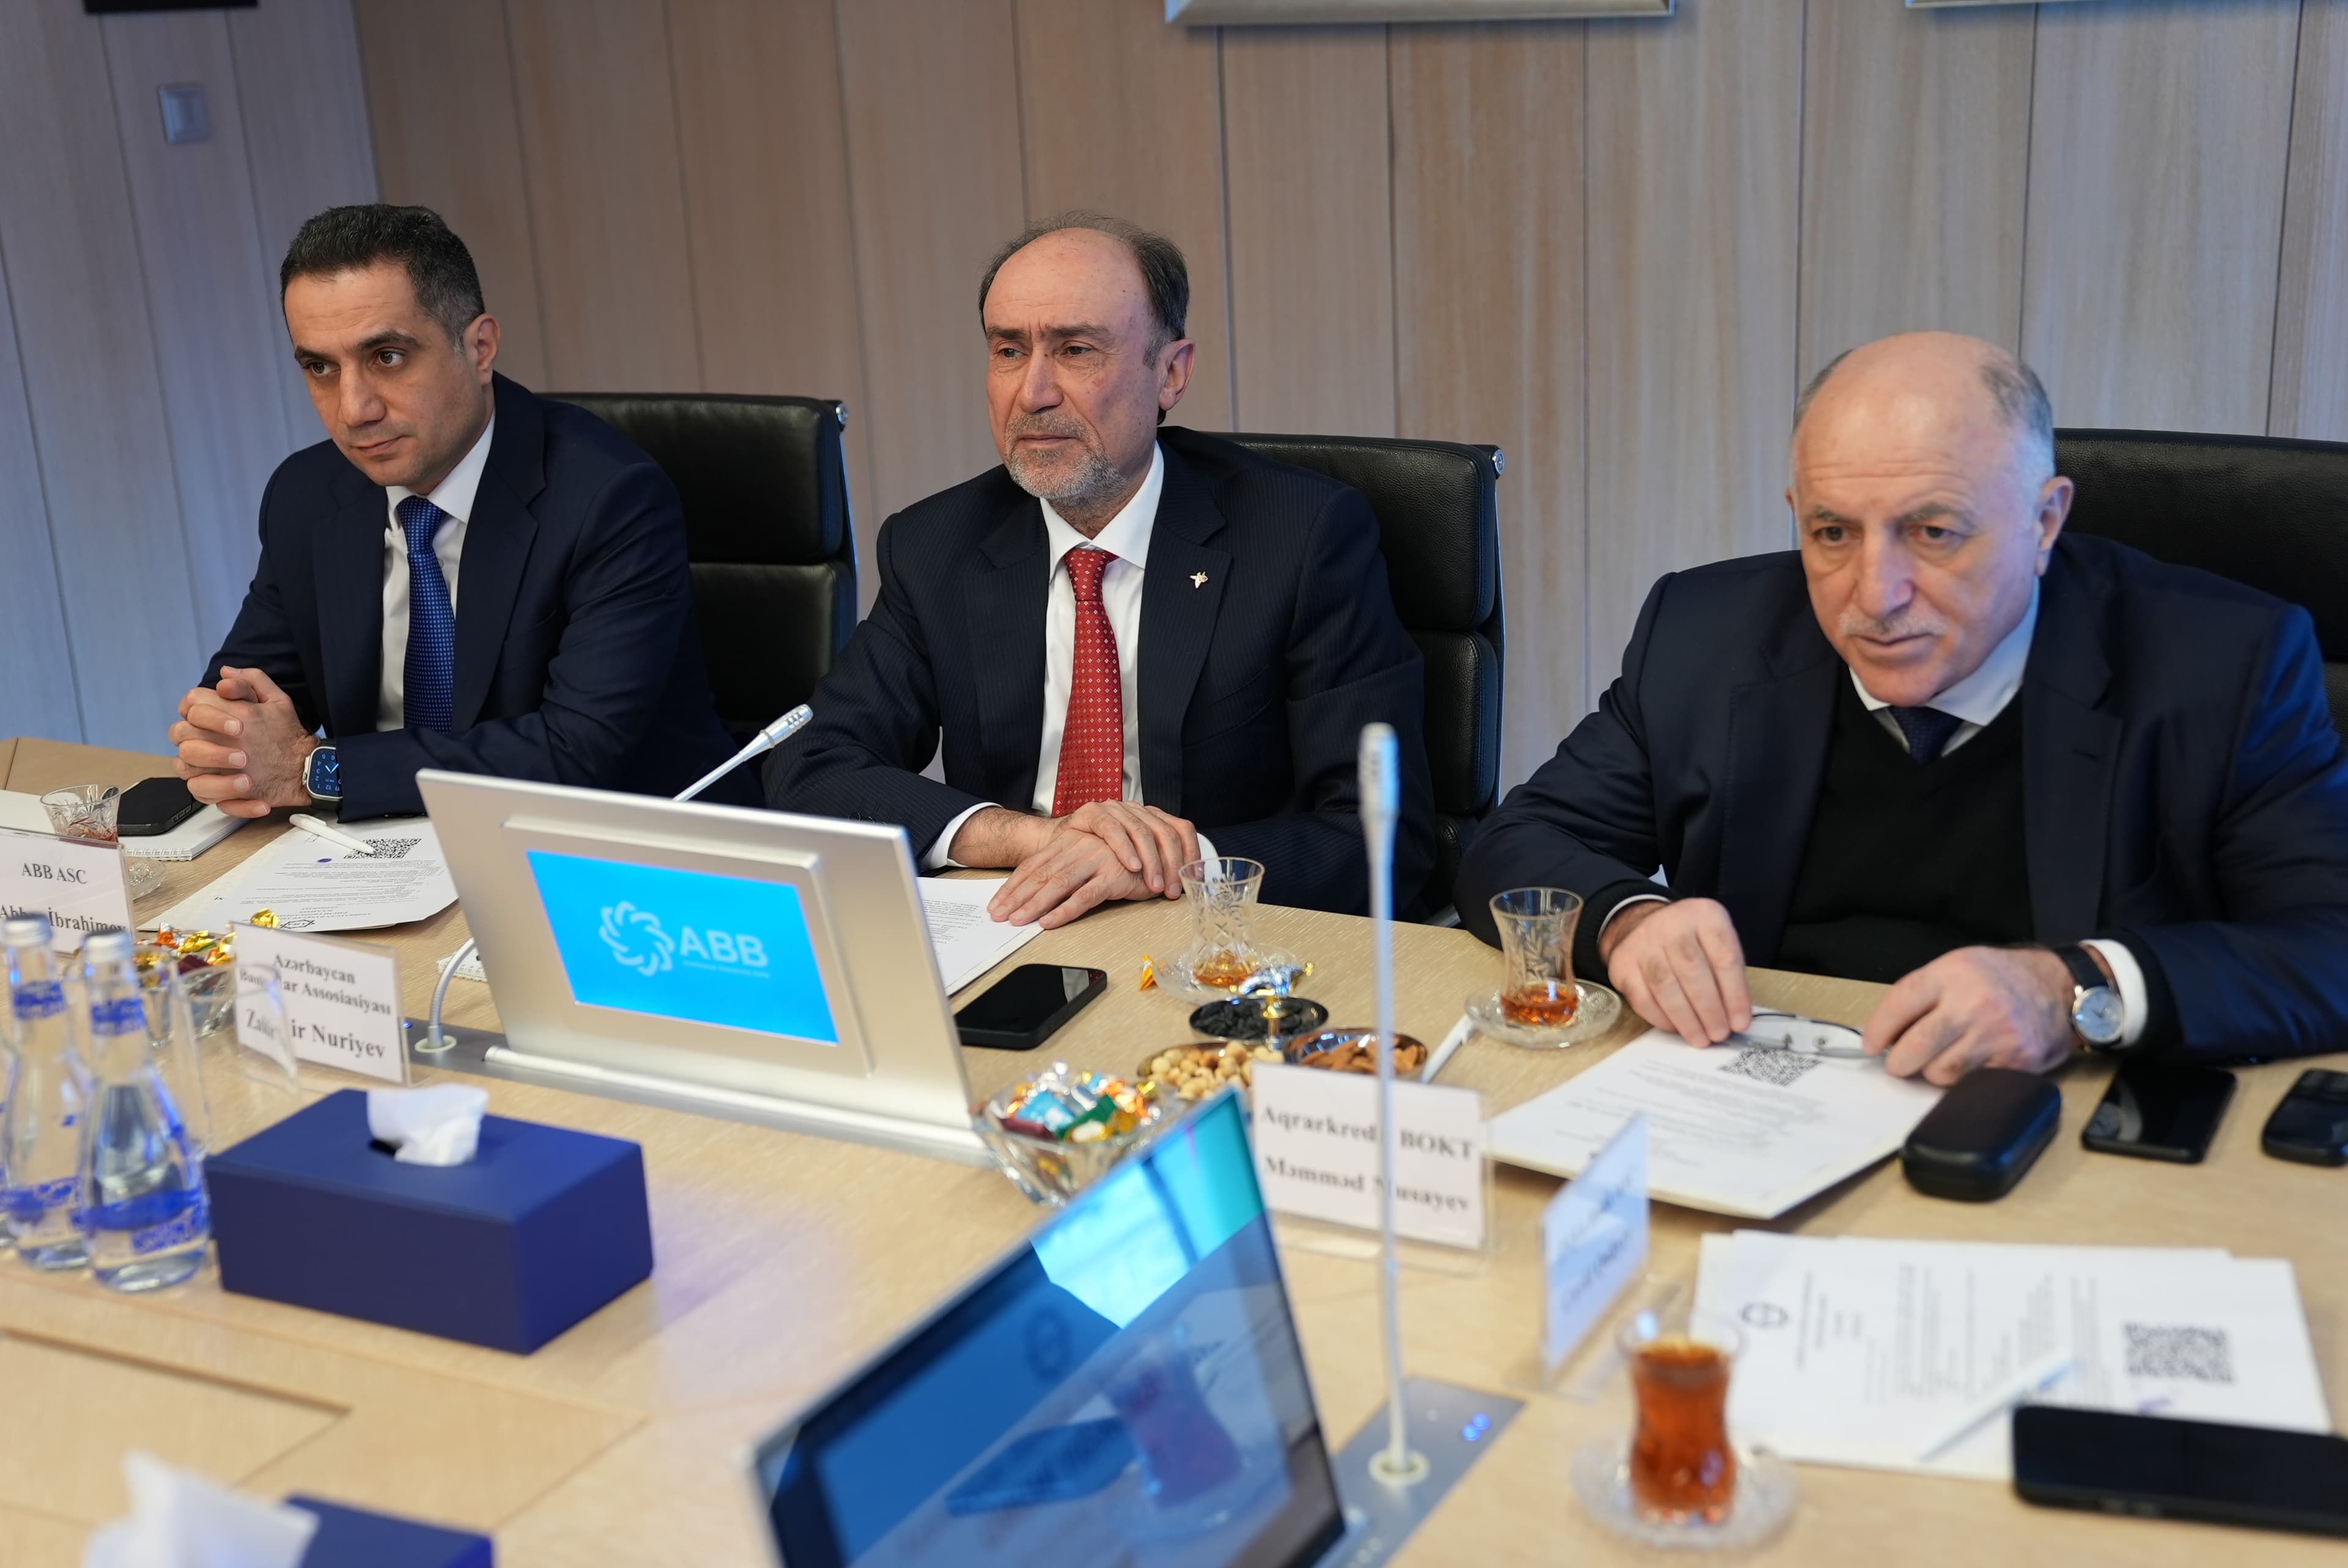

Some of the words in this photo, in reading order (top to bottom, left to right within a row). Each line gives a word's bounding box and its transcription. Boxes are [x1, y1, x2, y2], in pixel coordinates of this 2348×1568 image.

[22, 862, 53, 879] ABB
[56, 867, 87, 884] ASC
[679, 926, 769, 968] ABB
[312, 1024, 386, 1058] Nuriyev
[1400, 1129, 1474, 1160] BOKT
[1264, 1156, 1365, 1193] Məmməd
